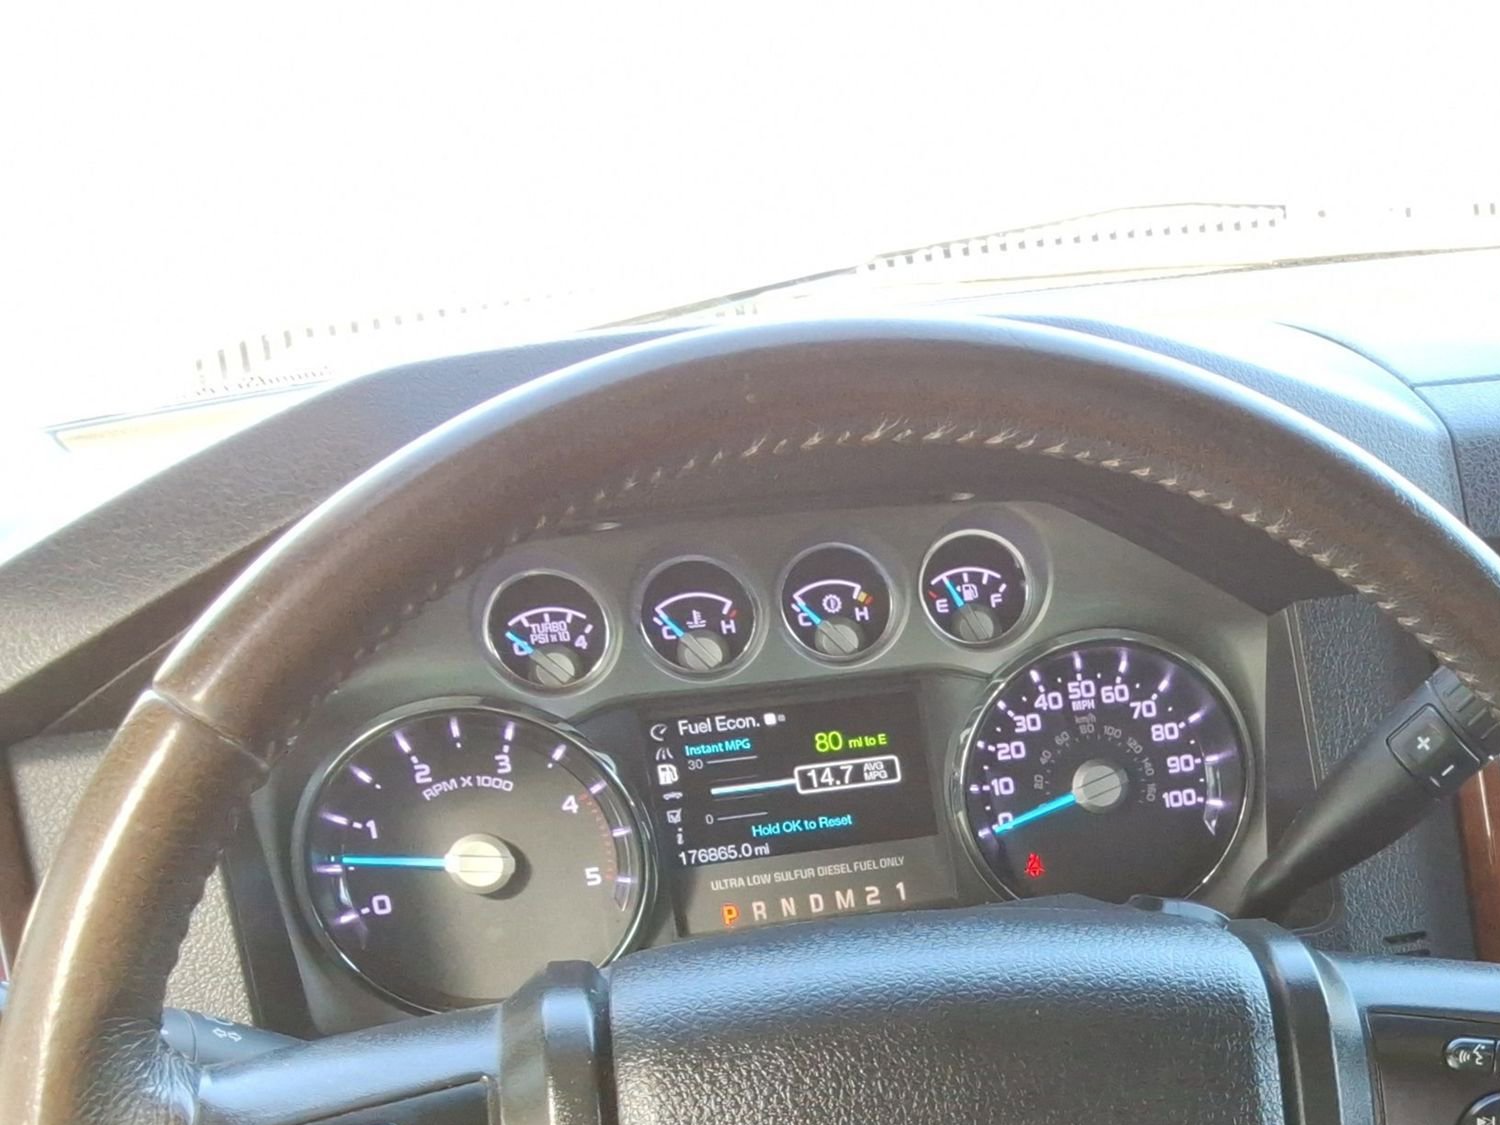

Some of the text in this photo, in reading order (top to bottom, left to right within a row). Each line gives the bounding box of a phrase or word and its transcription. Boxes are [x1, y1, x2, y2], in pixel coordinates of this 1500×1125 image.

[935, 598, 949, 614] E
[990, 592, 1003, 609] F
[854, 608, 870, 621] H
[529, 620, 568, 634] TURBO
[720, 618, 737, 635] H
[530, 631, 550, 645] PSI
[574, 635, 589, 650] 4
[1067, 680, 1096, 699] 50
[1100, 684, 1130, 705] 60
[1034, 691, 1064, 711] 40
[1071, 698, 1096, 712] MPH
[1129, 699, 1158, 720] 70
[678, 714, 761, 736] Fuel Econ.
[1013, 713, 1042, 734] 30
[1079, 723, 1095, 735] 80
[1103, 724, 1122, 739] 100
[1151, 722, 1180, 742] 80
[684, 738, 752, 757] Instant MPG
[813, 730, 843, 753] 80
[864, 735, 877, 747] to
[877, 733, 888, 746] E
[1054, 731, 1071, 746] 60
[1126, 736, 1143, 755] 120
[996, 741, 1026, 761] 20
[1038, 750, 1052, 766] 40
[414, 764, 433, 784] 2
[494, 754, 512, 774] 3
[687, 758, 704, 771] 30
[863, 761, 885, 773] AVG
[1166, 754, 1195, 774] 90
[806, 765, 853, 789] 14.7
[863, 770, 889, 782] MPG
[991, 776, 1015, 796] 10
[421, 777, 458, 801] RPM
[475, 774, 515, 792] 1000
[561, 795, 579, 814] 4
[1162, 788, 1198, 809] 100
[365, 819, 379, 840] 1
[704, 814, 715, 825] 0
[751, 813, 853, 838] Hold OK to Reset
[678, 843, 753, 867] 176865.0
[584, 866, 602, 887] 5
[710, 855, 905, 892] ULTRA LOW SULFUR DIESEL FUEL ONLY
[372, 894, 392, 915] 0
[723, 881, 908, 926] P R N D M 2 1
